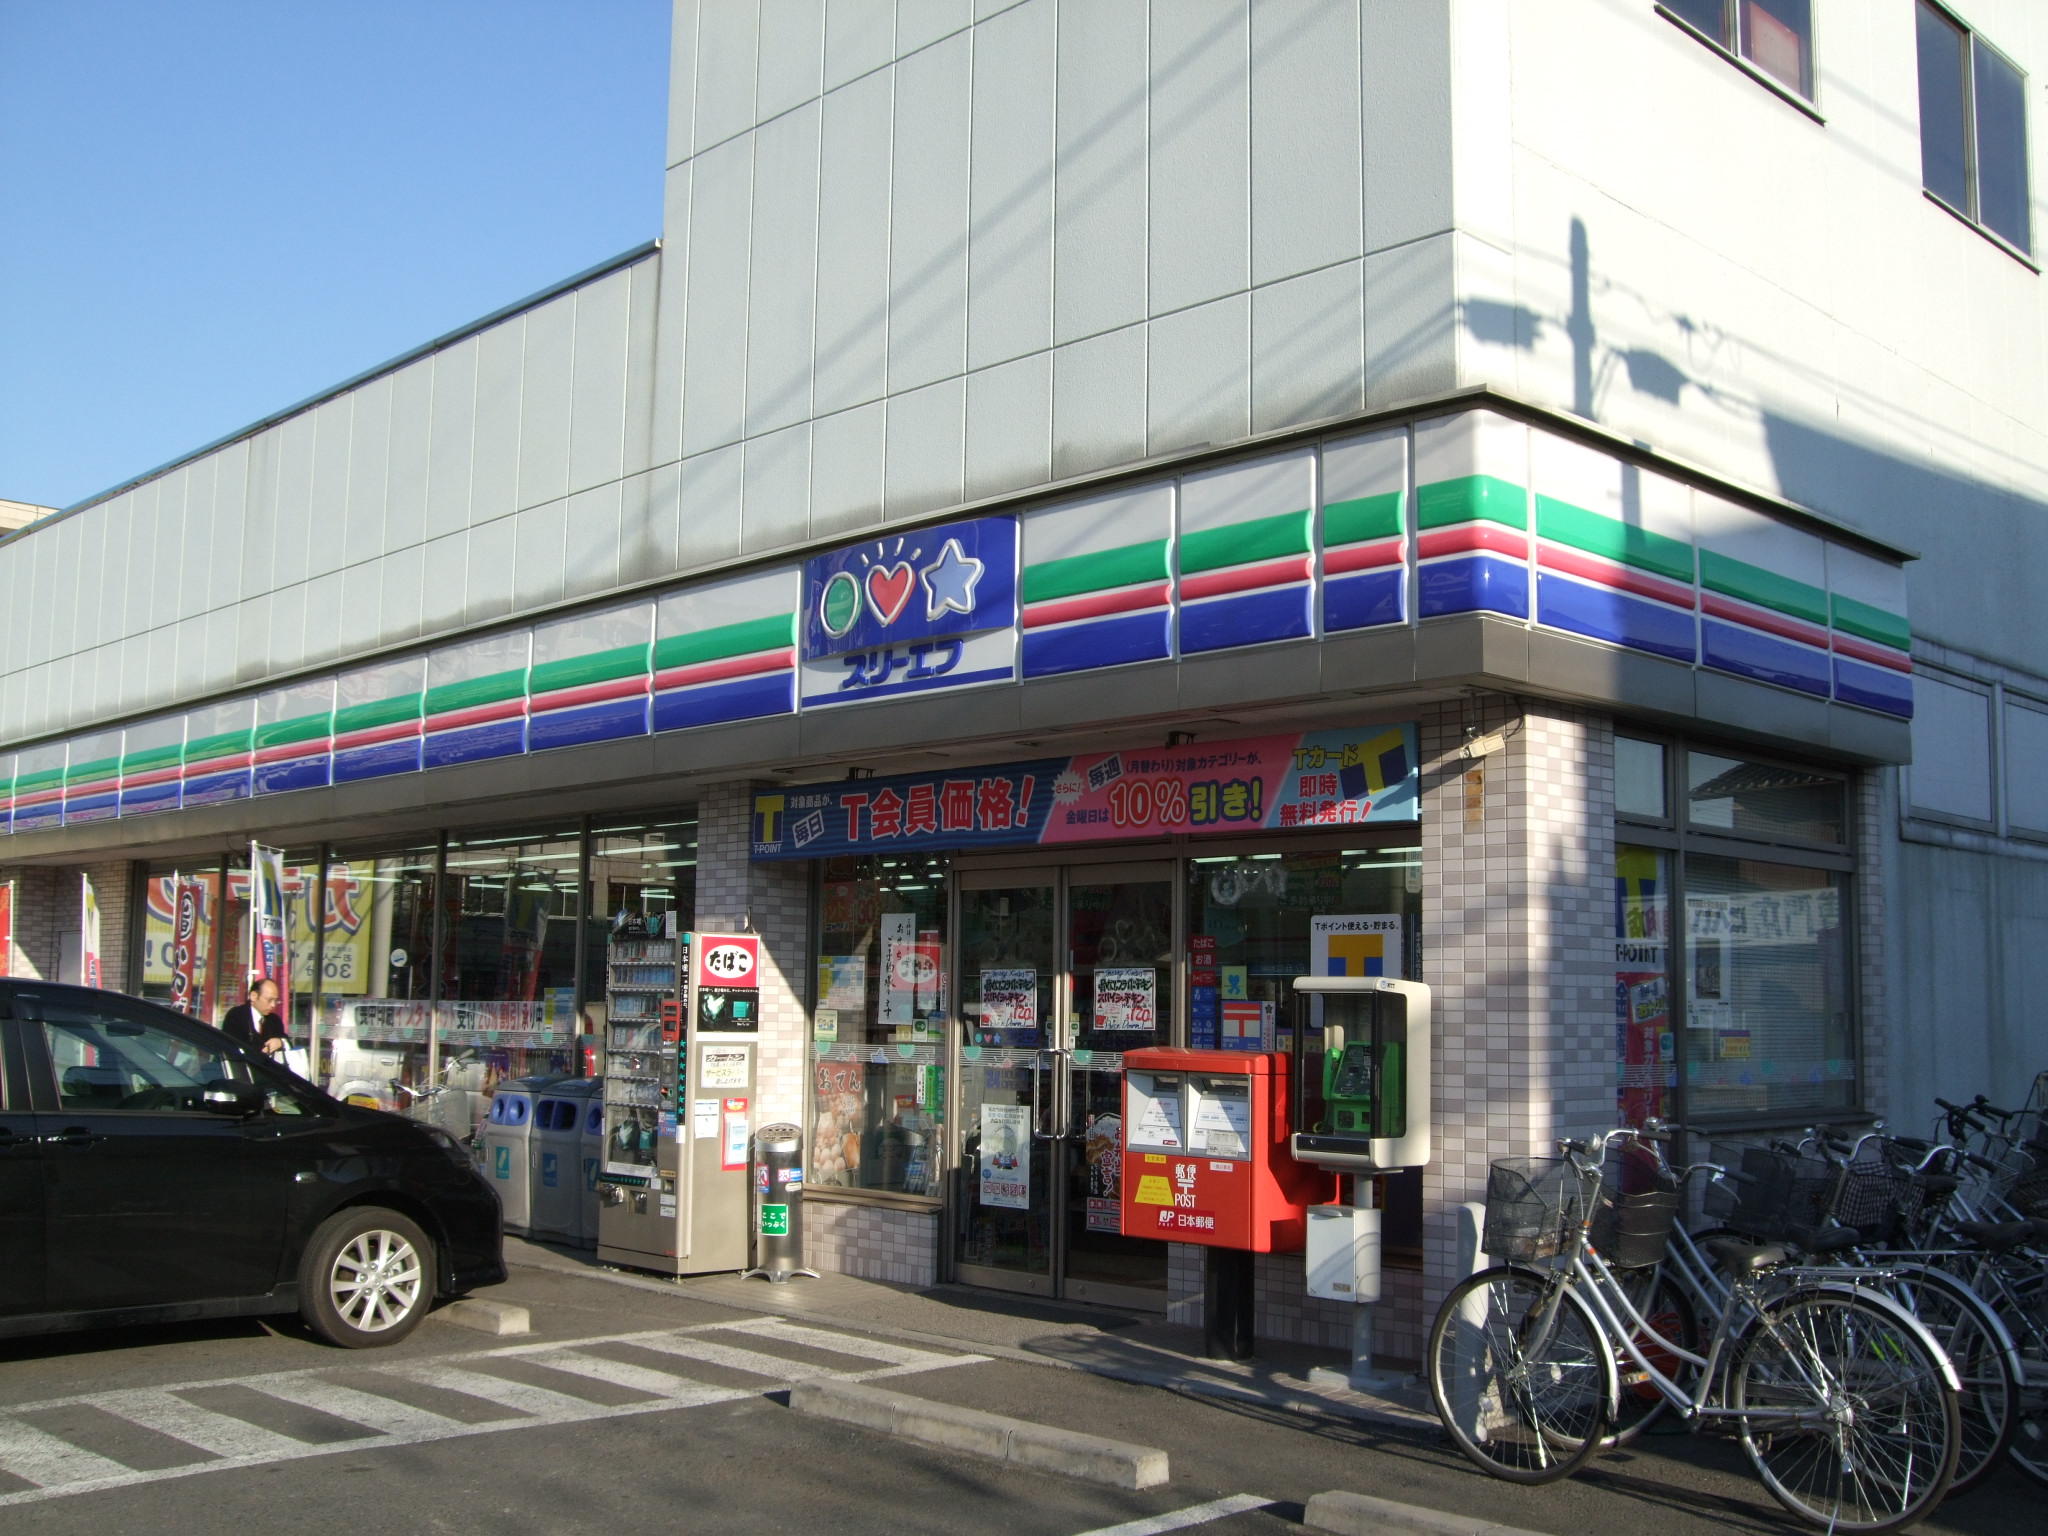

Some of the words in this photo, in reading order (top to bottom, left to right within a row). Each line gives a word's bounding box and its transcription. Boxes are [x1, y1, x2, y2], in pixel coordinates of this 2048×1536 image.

[842, 638, 964, 689] スリーエフ
[1293, 744, 1359, 769] Tカード
[1088, 754, 1123, 789] 毎週
[1298, 773, 1337, 798] 即時
[1065, 807, 1109, 825] 金曜日は
[1279, 799, 1372, 828] 無料発行!
[794, 813, 824, 845] 毎日
[753, 843, 783, 855] T-POINT
[1193, 938, 1214, 948] たばこ
[709, 951, 748, 973] たばこ
[1195, 954, 1212, 965] お酒
[818, 1067, 861, 1092] おでん
[1175, 1163, 1197, 1180] 郵便
[1174, 1193, 1197, 1208] POST
[762, 1212, 786, 1220] ここで
[1178, 1214, 1214, 1230] 日本郵便
